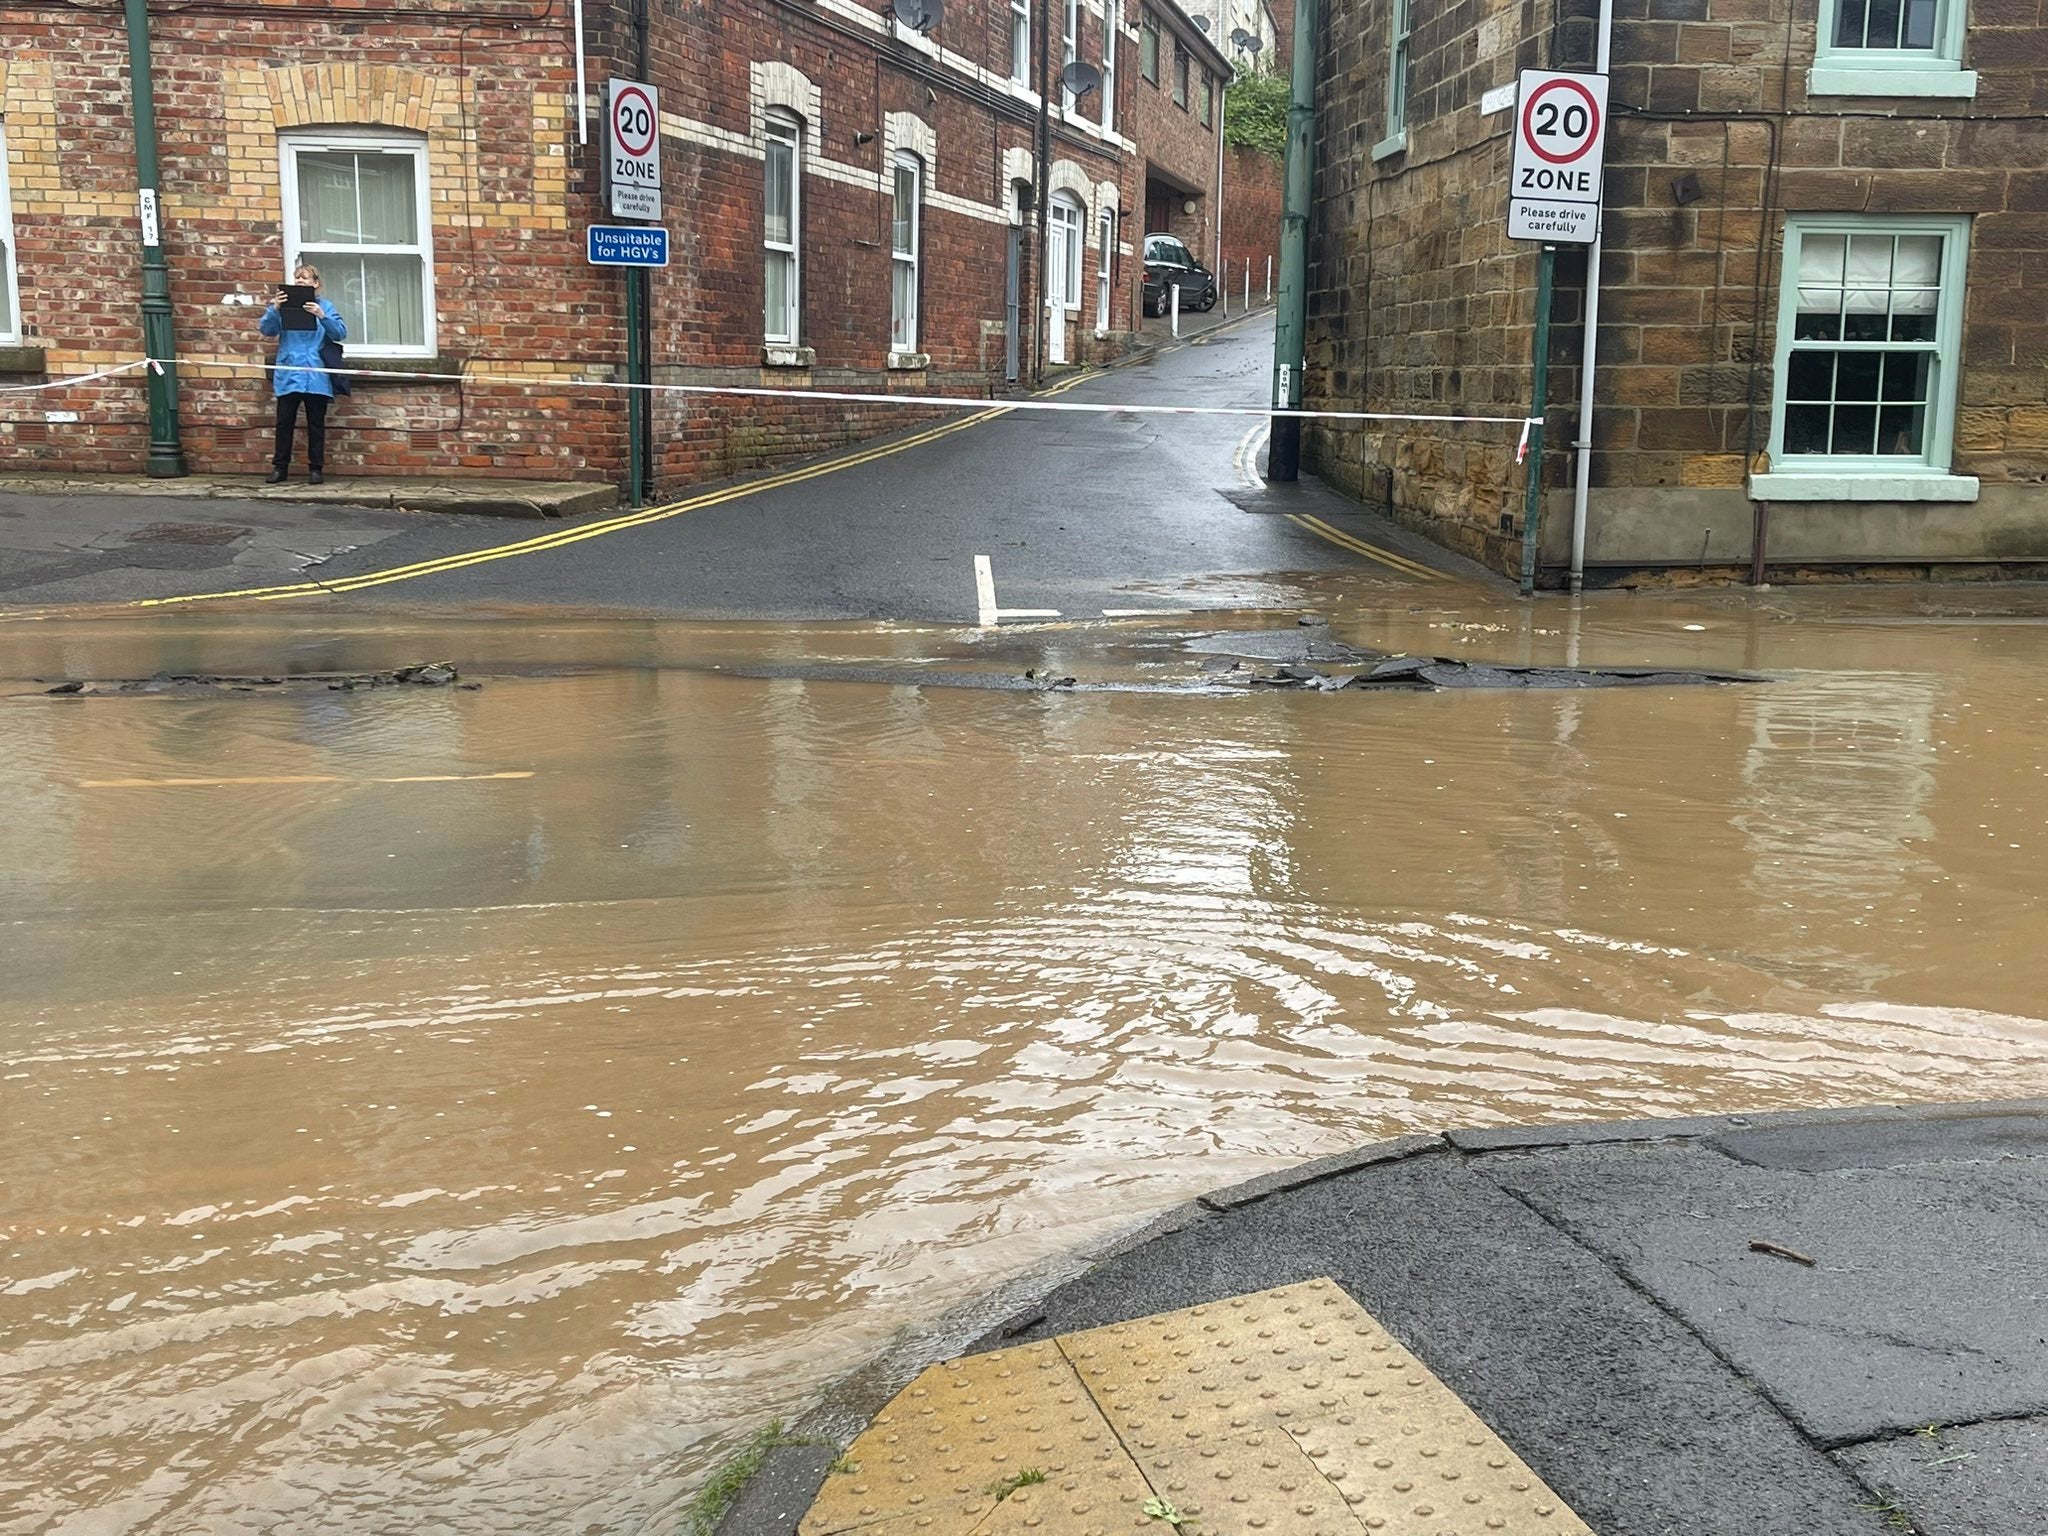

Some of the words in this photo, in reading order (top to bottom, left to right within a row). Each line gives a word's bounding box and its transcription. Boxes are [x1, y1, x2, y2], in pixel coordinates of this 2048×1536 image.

[620, 106, 650, 136] 20
[1536, 103, 1588, 138] 20
[616, 158, 656, 180] ZONE
[1521, 168, 1590, 192] ZONE
[617, 190, 638, 200] Please
[639, 192, 655, 202] drive
[623, 203, 650, 214] carefully
[1520, 206, 1556, 218] Please
[1559, 209, 1586, 220] drive
[1528, 221, 1577, 234] carefully
[594, 231, 662, 246] Unsuitable
[598, 245, 616, 257] for
[621, 246, 659, 259] HGV's
